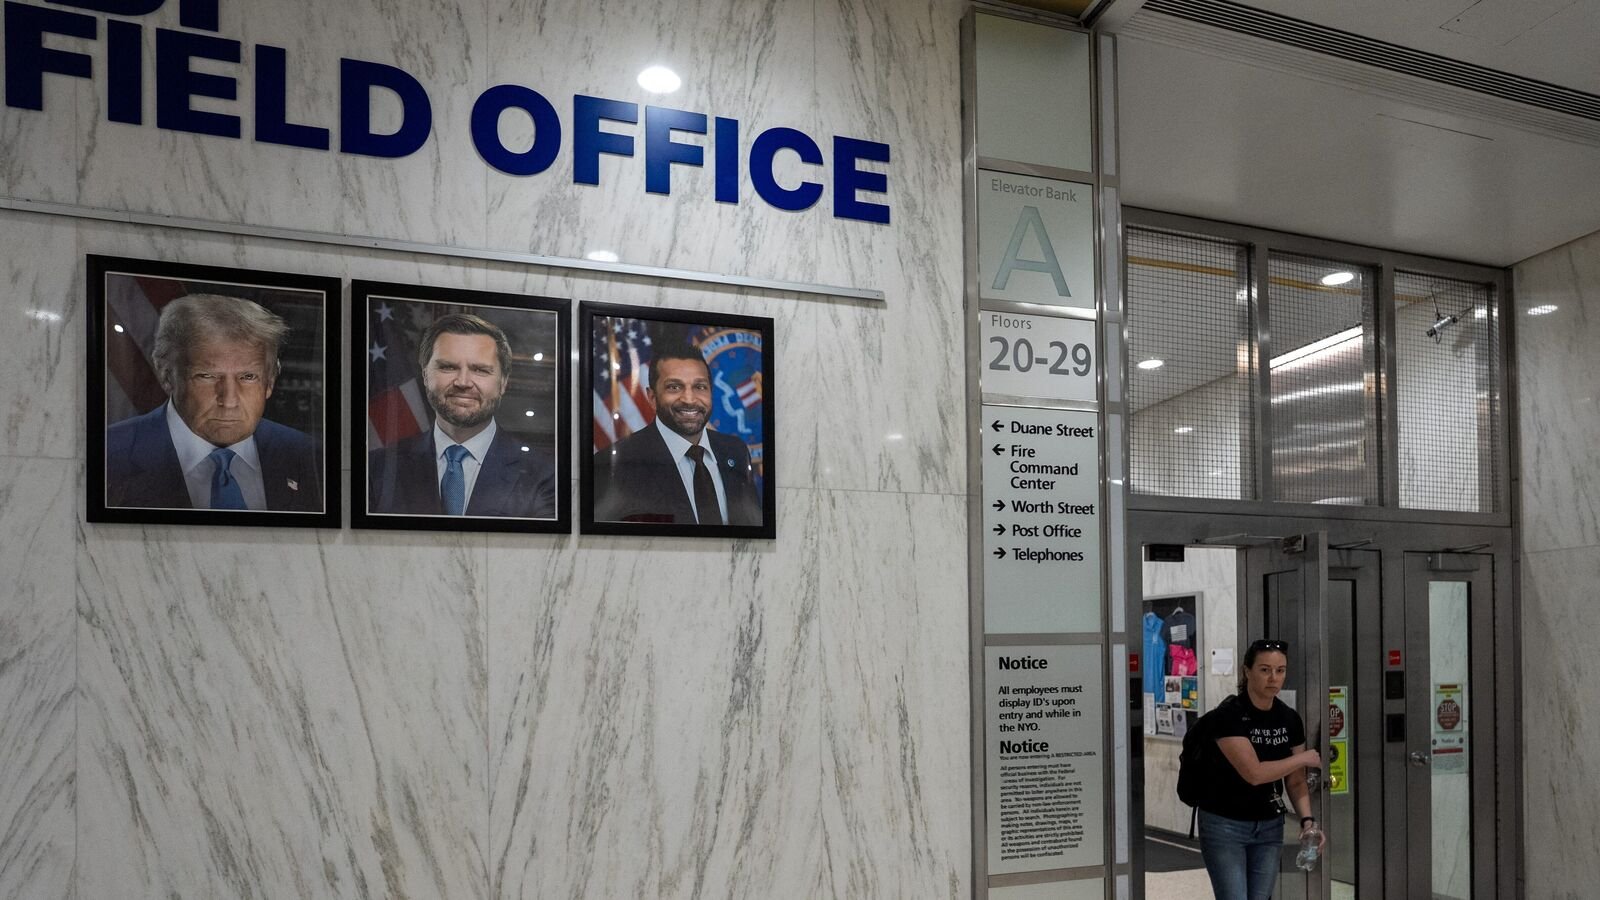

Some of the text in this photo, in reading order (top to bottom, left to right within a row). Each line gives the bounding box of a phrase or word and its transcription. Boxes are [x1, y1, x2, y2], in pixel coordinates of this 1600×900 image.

[4, 0, 890, 225] FIELD OFFICE
[992, 178, 1076, 202] Elevator Bank
[992, 205, 1072, 298] A
[992, 314, 1032, 330] Floors
[989, 336, 1091, 376] 20-29
[1011, 421, 1094, 438] Duane Street
[1011, 445, 1035, 457] Fire
[1010, 460, 1078, 475] Command
[1010, 476, 1056, 490] Center
[1012, 500, 1095, 515] Worth Street
[1012, 524, 1082, 538] Post Office
[1012, 548, 1083, 563] Telephones
[998, 656, 1048, 670] Notice
[998, 686, 1009, 695] All
[1012, 685, 1059, 696] employees
[999, 698, 1075, 709] display ID's upon
[1440, 703, 1457, 712] STOP
[999, 711, 1023, 721] entry
[1026, 710, 1043, 719] and
[1045, 709, 1070, 718] while
[1330, 708, 1340, 717] OP
[999, 723, 1040, 732] the NYO.
[1000, 739, 1049, 754] Notice
